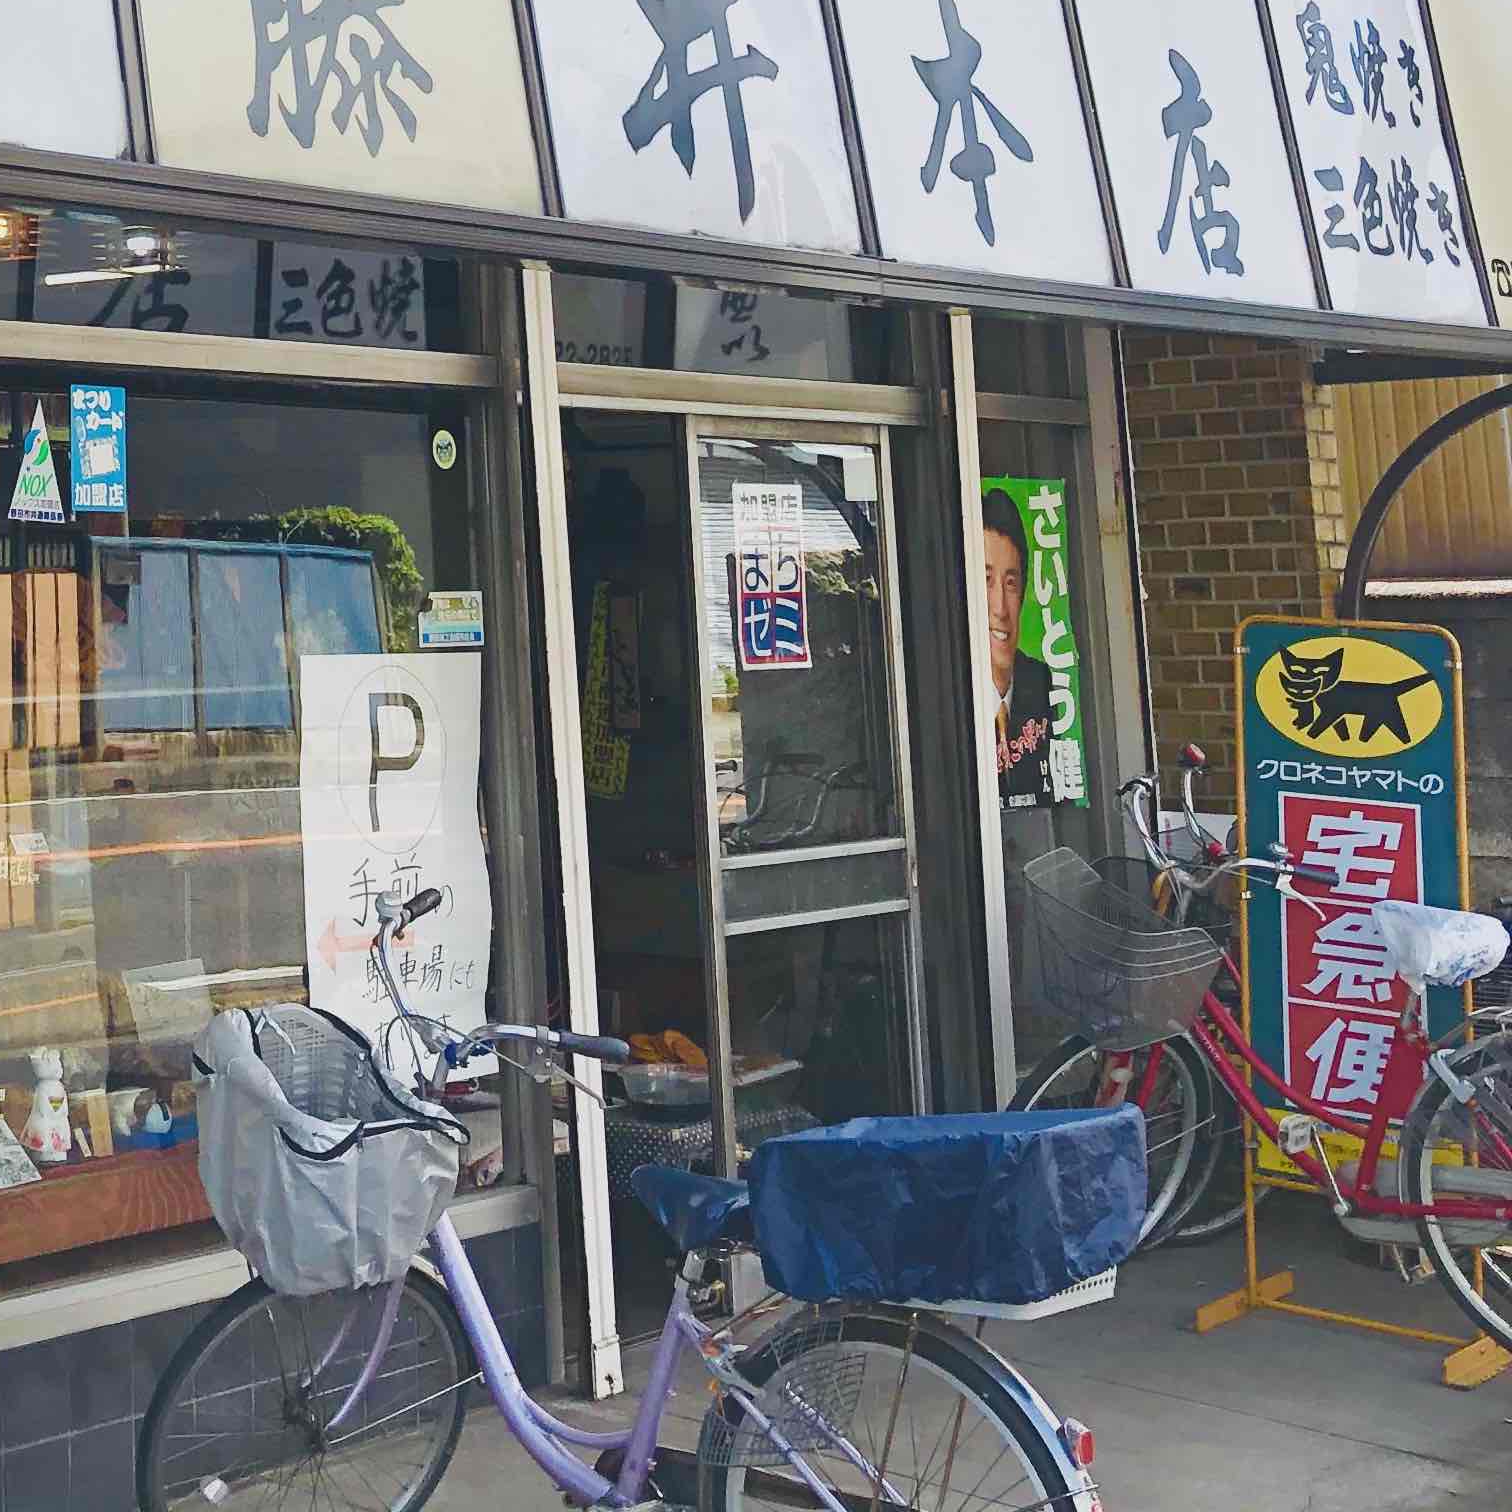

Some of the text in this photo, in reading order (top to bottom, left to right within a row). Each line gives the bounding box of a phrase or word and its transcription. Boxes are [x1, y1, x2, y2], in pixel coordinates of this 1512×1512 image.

[1295, 0, 1424, 130] 鬼焼き
[1313, 154, 1462, 268] 三色焼き
[19, 473, 54, 497] NOX
[74, 482, 125, 507] 加盟店
[368, 691, 425, 833] P
[1256, 758, 1445, 796] クロネコヤマトの
[1300, 809, 1403, 1106] 宅急便
